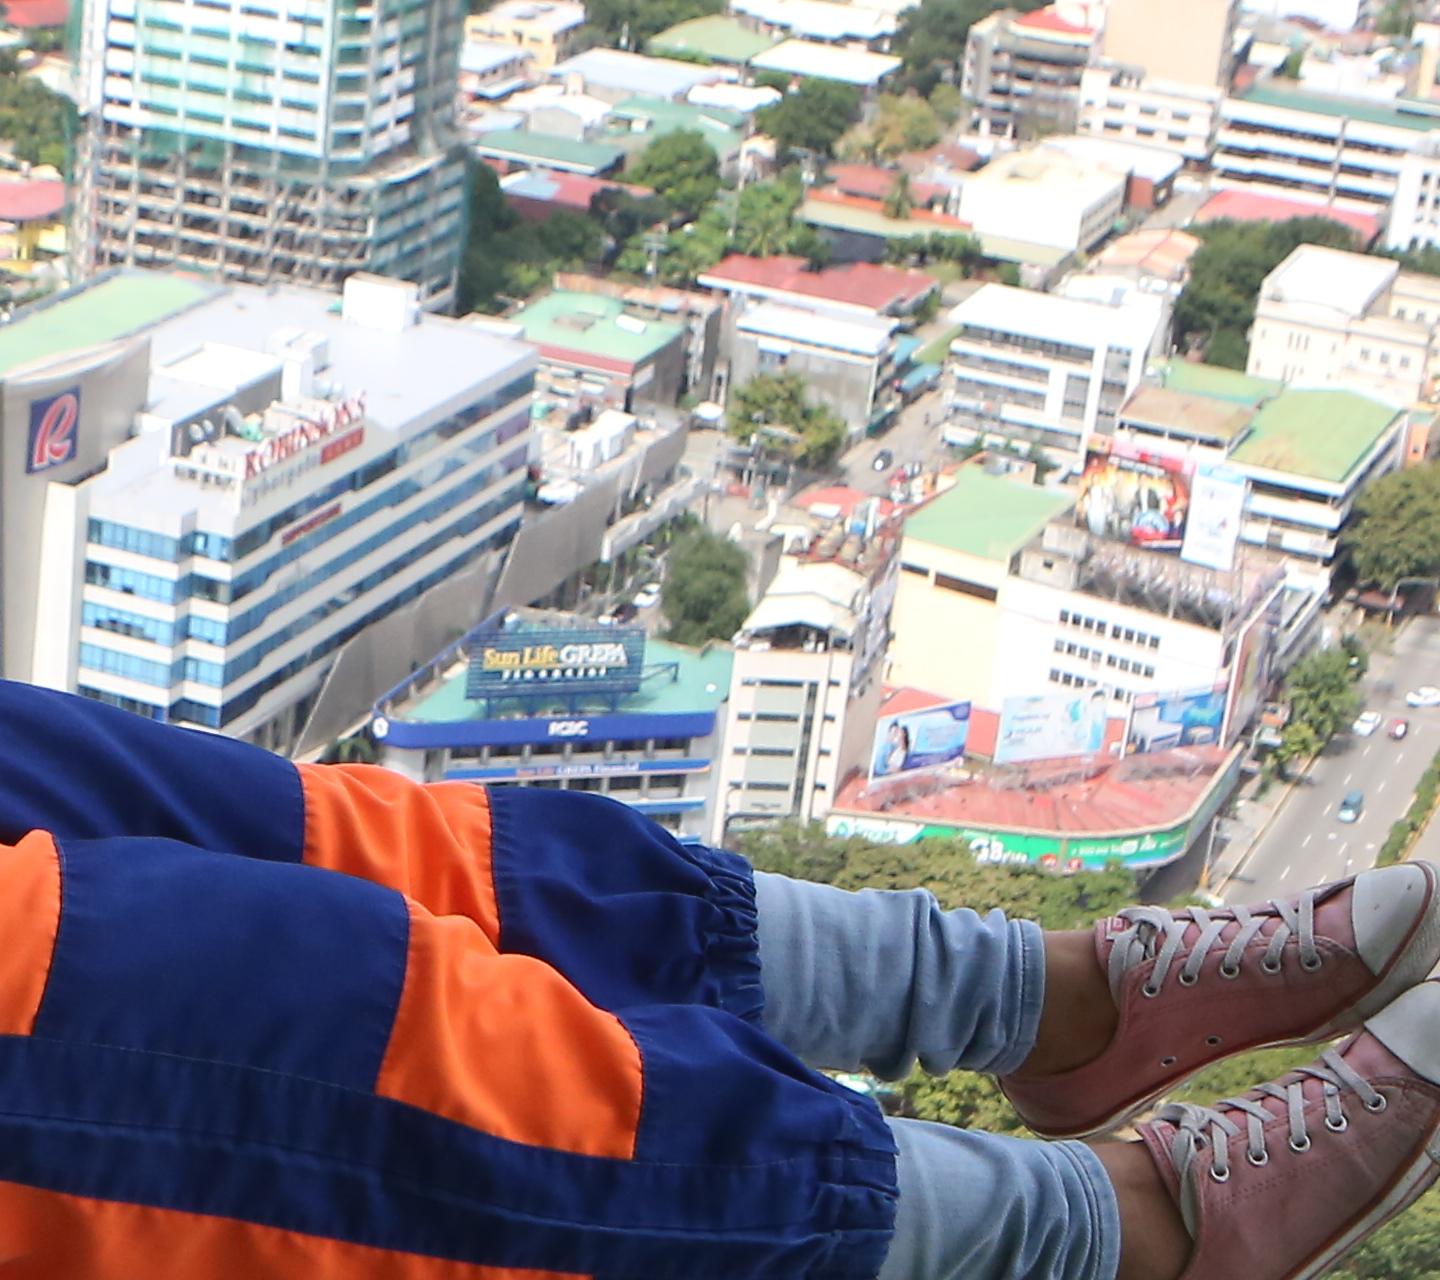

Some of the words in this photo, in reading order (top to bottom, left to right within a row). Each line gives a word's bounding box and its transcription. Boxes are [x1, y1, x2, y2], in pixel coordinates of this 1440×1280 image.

[243, 391, 368, 482] ROBINSONS
[483, 648, 521, 669] Sun
[523, 645, 559, 668] Life
[560, 642, 628, 667] GREPA
[548, 721, 589, 736] RCBC
